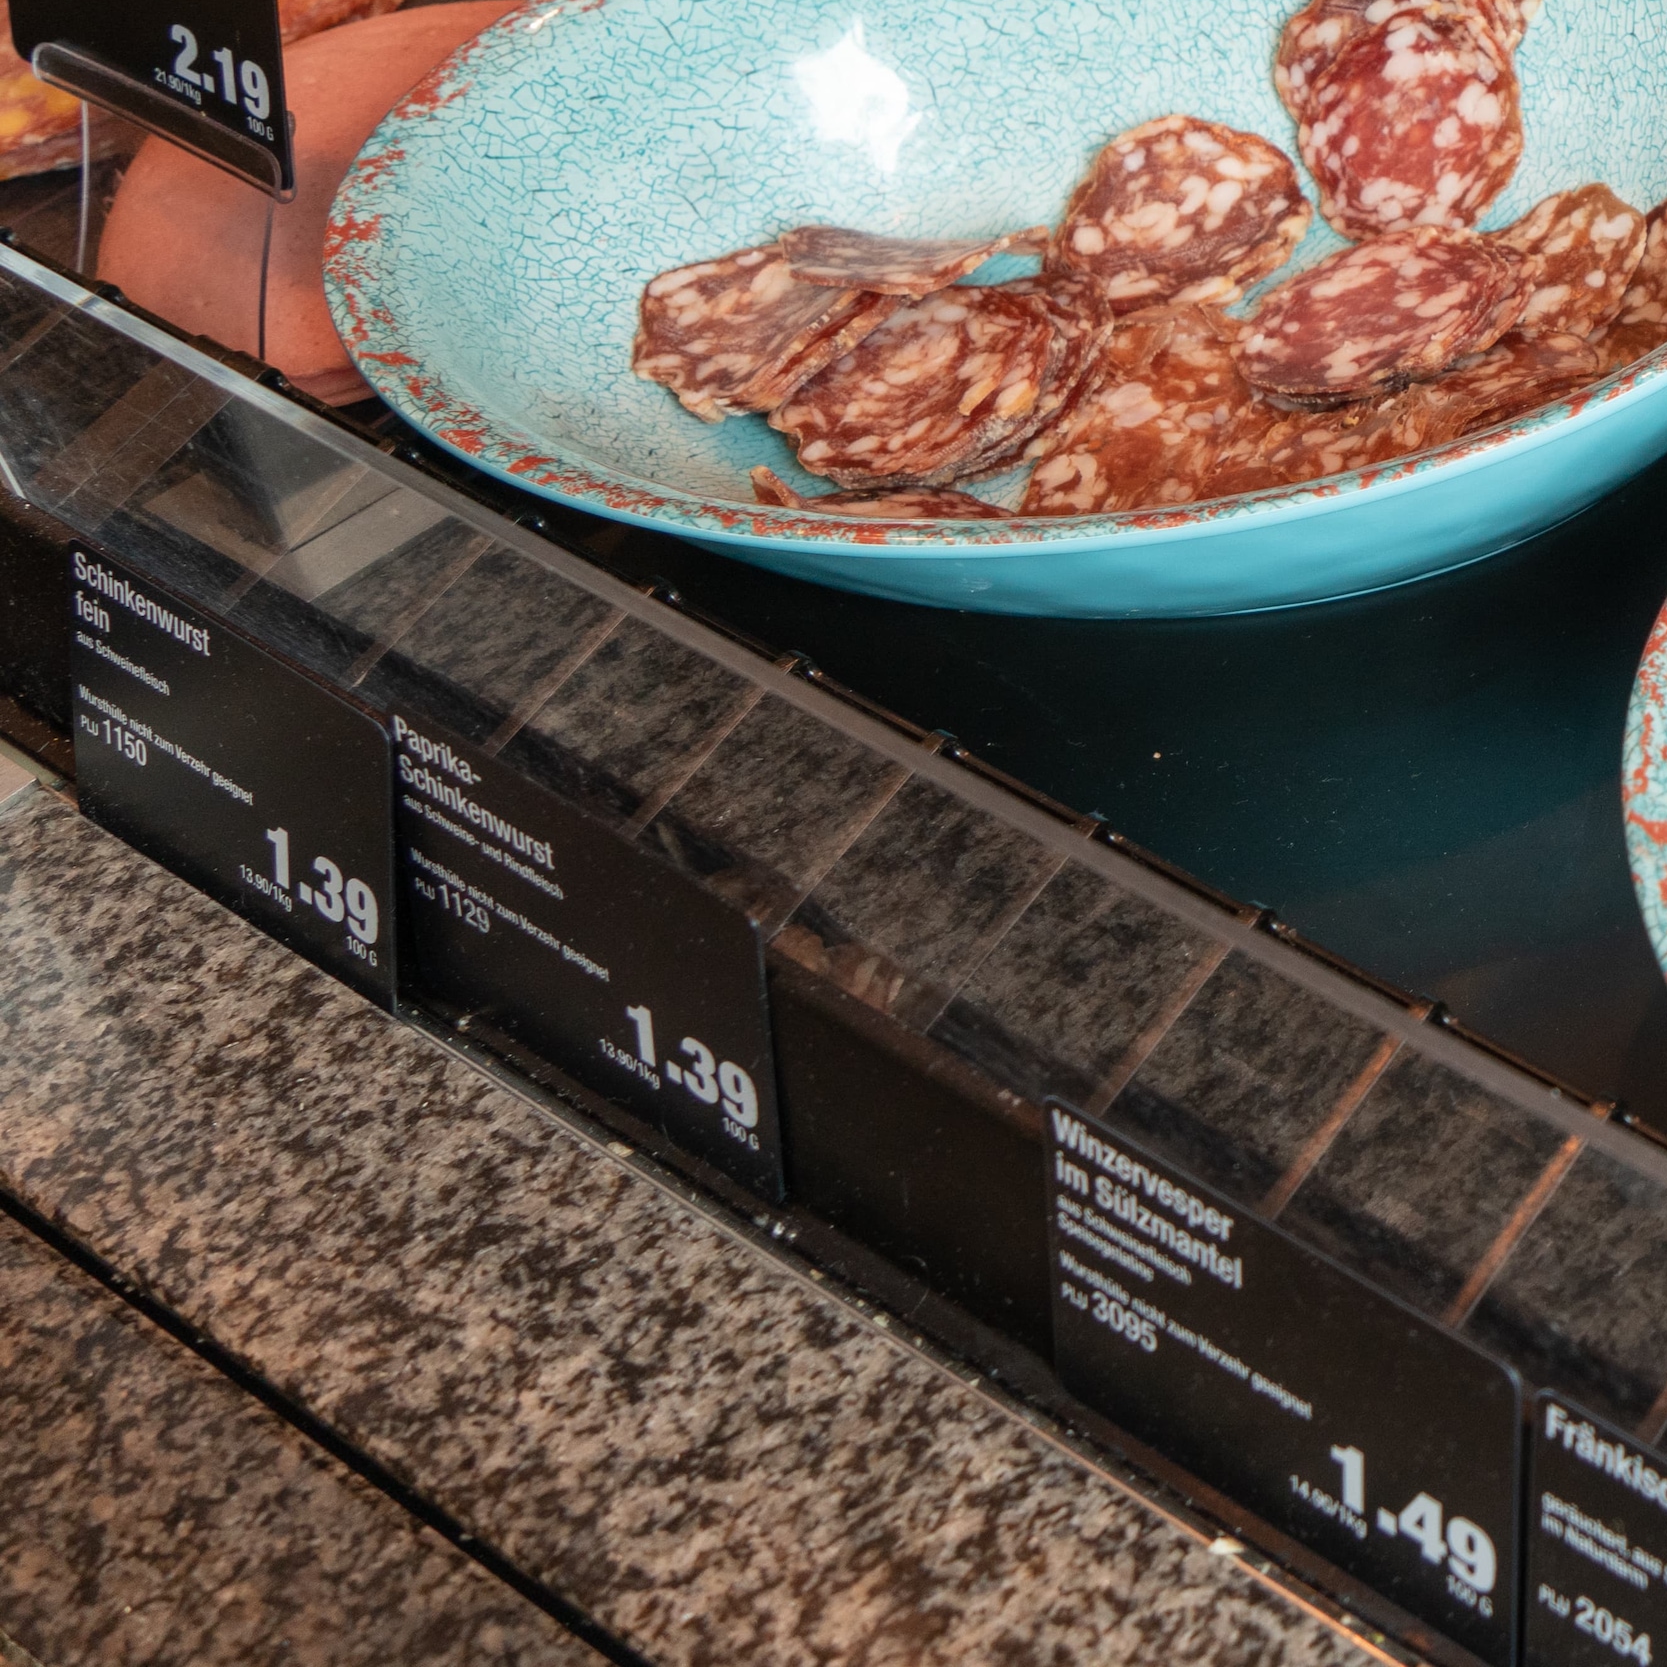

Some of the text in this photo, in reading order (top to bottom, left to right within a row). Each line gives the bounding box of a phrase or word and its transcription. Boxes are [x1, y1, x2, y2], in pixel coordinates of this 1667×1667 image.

[153, 66, 202, 105] 21.90/1kg
[170, 24, 270, 118] 2.19
[73, 551, 211, 657] Schinkenwurst
[74, 589, 110, 633] fein
[75, 630, 170, 696] aus Schweinefleisch
[78, 683, 253, 806] Wursthülle nicht zum Verzehr geeignet
[80, 713, 147, 766] PLU 1150
[392, 713, 482, 785] Paprika-
[398, 753, 555, 870] Schinkenwurst
[403, 793, 564, 900] aus Schweine- und Rindfleisch
[238, 863, 292, 911] 13.90/1kg
[268, 827, 378, 945] 1.39
[414, 876, 490, 933] PLU 1129
[345, 934, 377, 967] 100 G
[598, 1037, 660, 1090] 13.90/1kg
[626, 1005, 758, 1128] 1.39
[1051, 1108, 1234, 1241] Winzervesper
[1055, 1150, 1242, 1289] im Sülzmantel
[1056, 1193, 1191, 1285] aus Schweinefleisch
[1061, 1281, 1157, 1352] PLU 3095
[1288, 1474, 1367, 1539] 14.90/1kg
[1331, 1444, 1497, 1592] 1.49
[1537, 1583, 1652, 1667] PLU 2054
